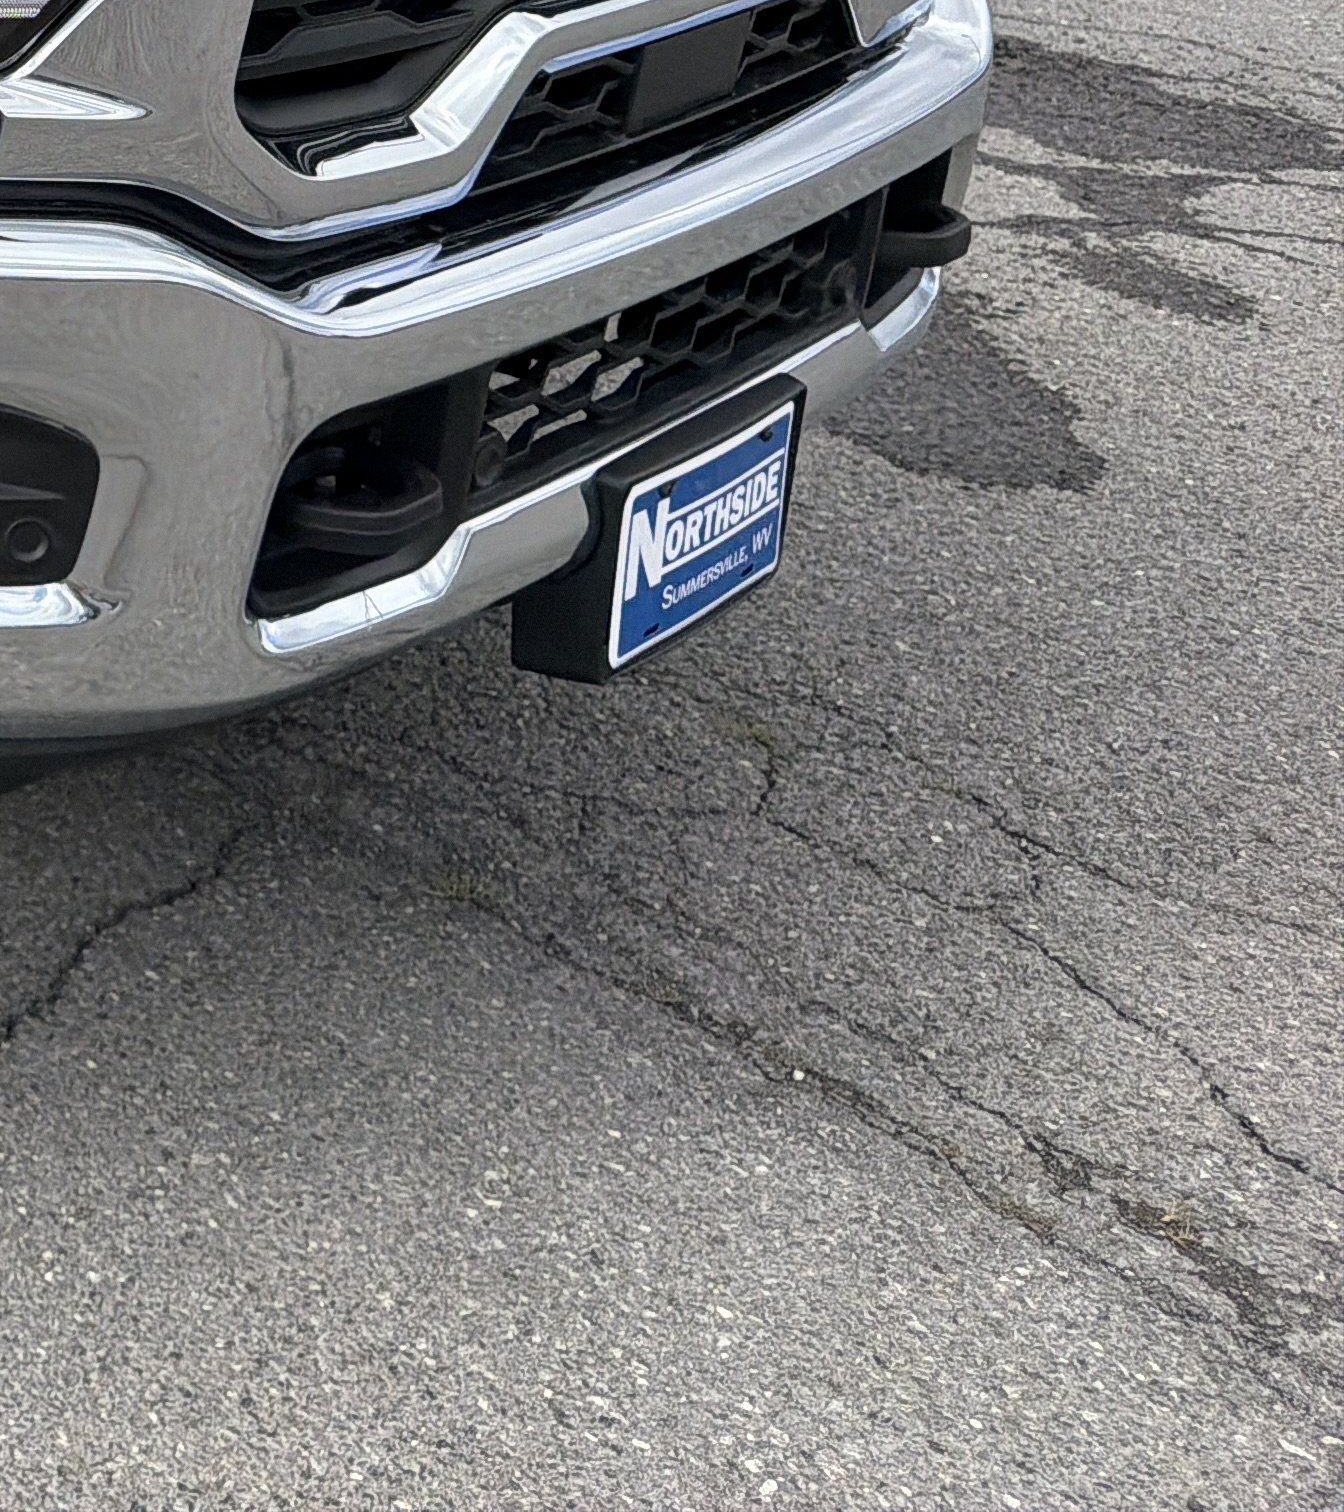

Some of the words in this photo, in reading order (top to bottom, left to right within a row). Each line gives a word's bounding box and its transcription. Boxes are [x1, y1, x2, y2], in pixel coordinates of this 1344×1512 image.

[625, 460, 782, 601] NORTHSIDE
[662, 548, 749, 610] SUMMERSVILLE,
[752, 524, 773, 555] WV
